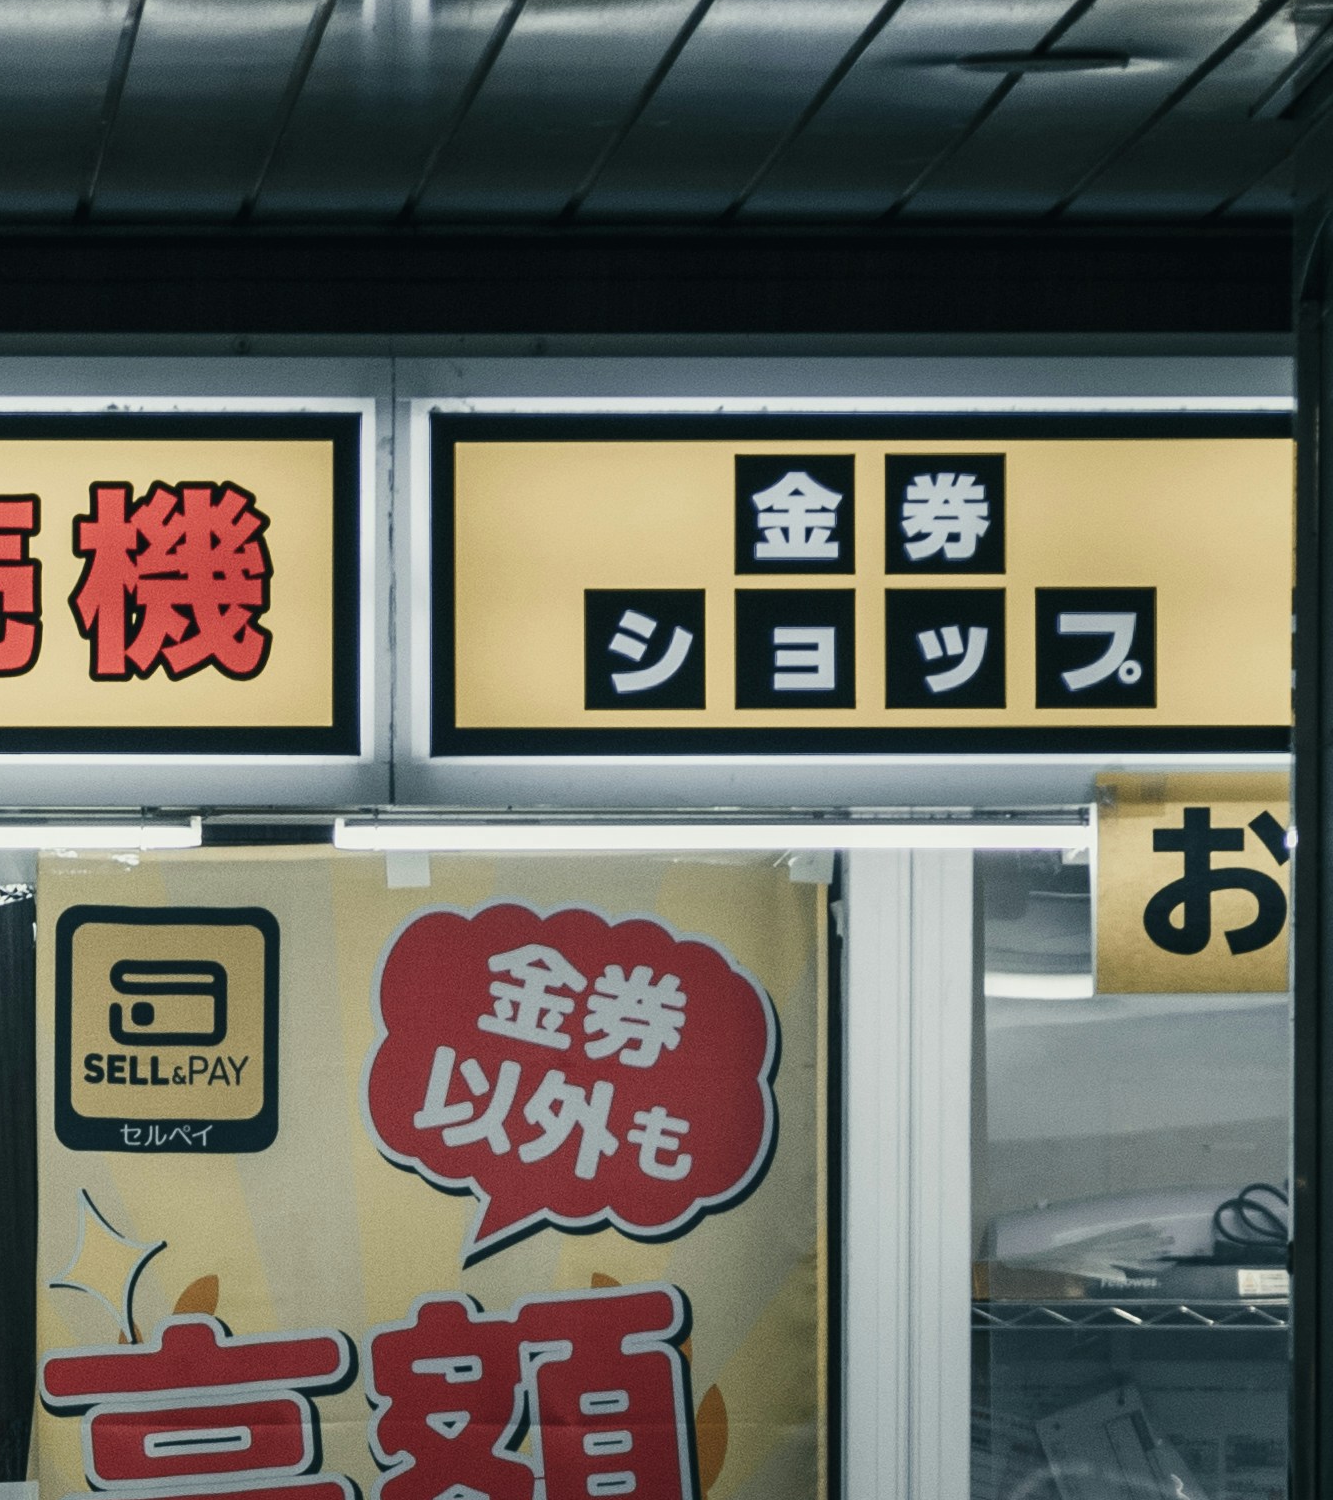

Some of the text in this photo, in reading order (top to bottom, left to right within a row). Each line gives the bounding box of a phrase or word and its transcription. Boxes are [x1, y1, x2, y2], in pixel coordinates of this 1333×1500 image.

[751, 470, 992, 562] 金券
[607, 608, 1143, 694] ショップ
[477, 942, 687, 1068] 金券
[83, 1051, 249, 1089] SELL&PAY
[412, 1044, 694, 1181] 以外も
[119, 1121, 213, 1150] セルペイ
